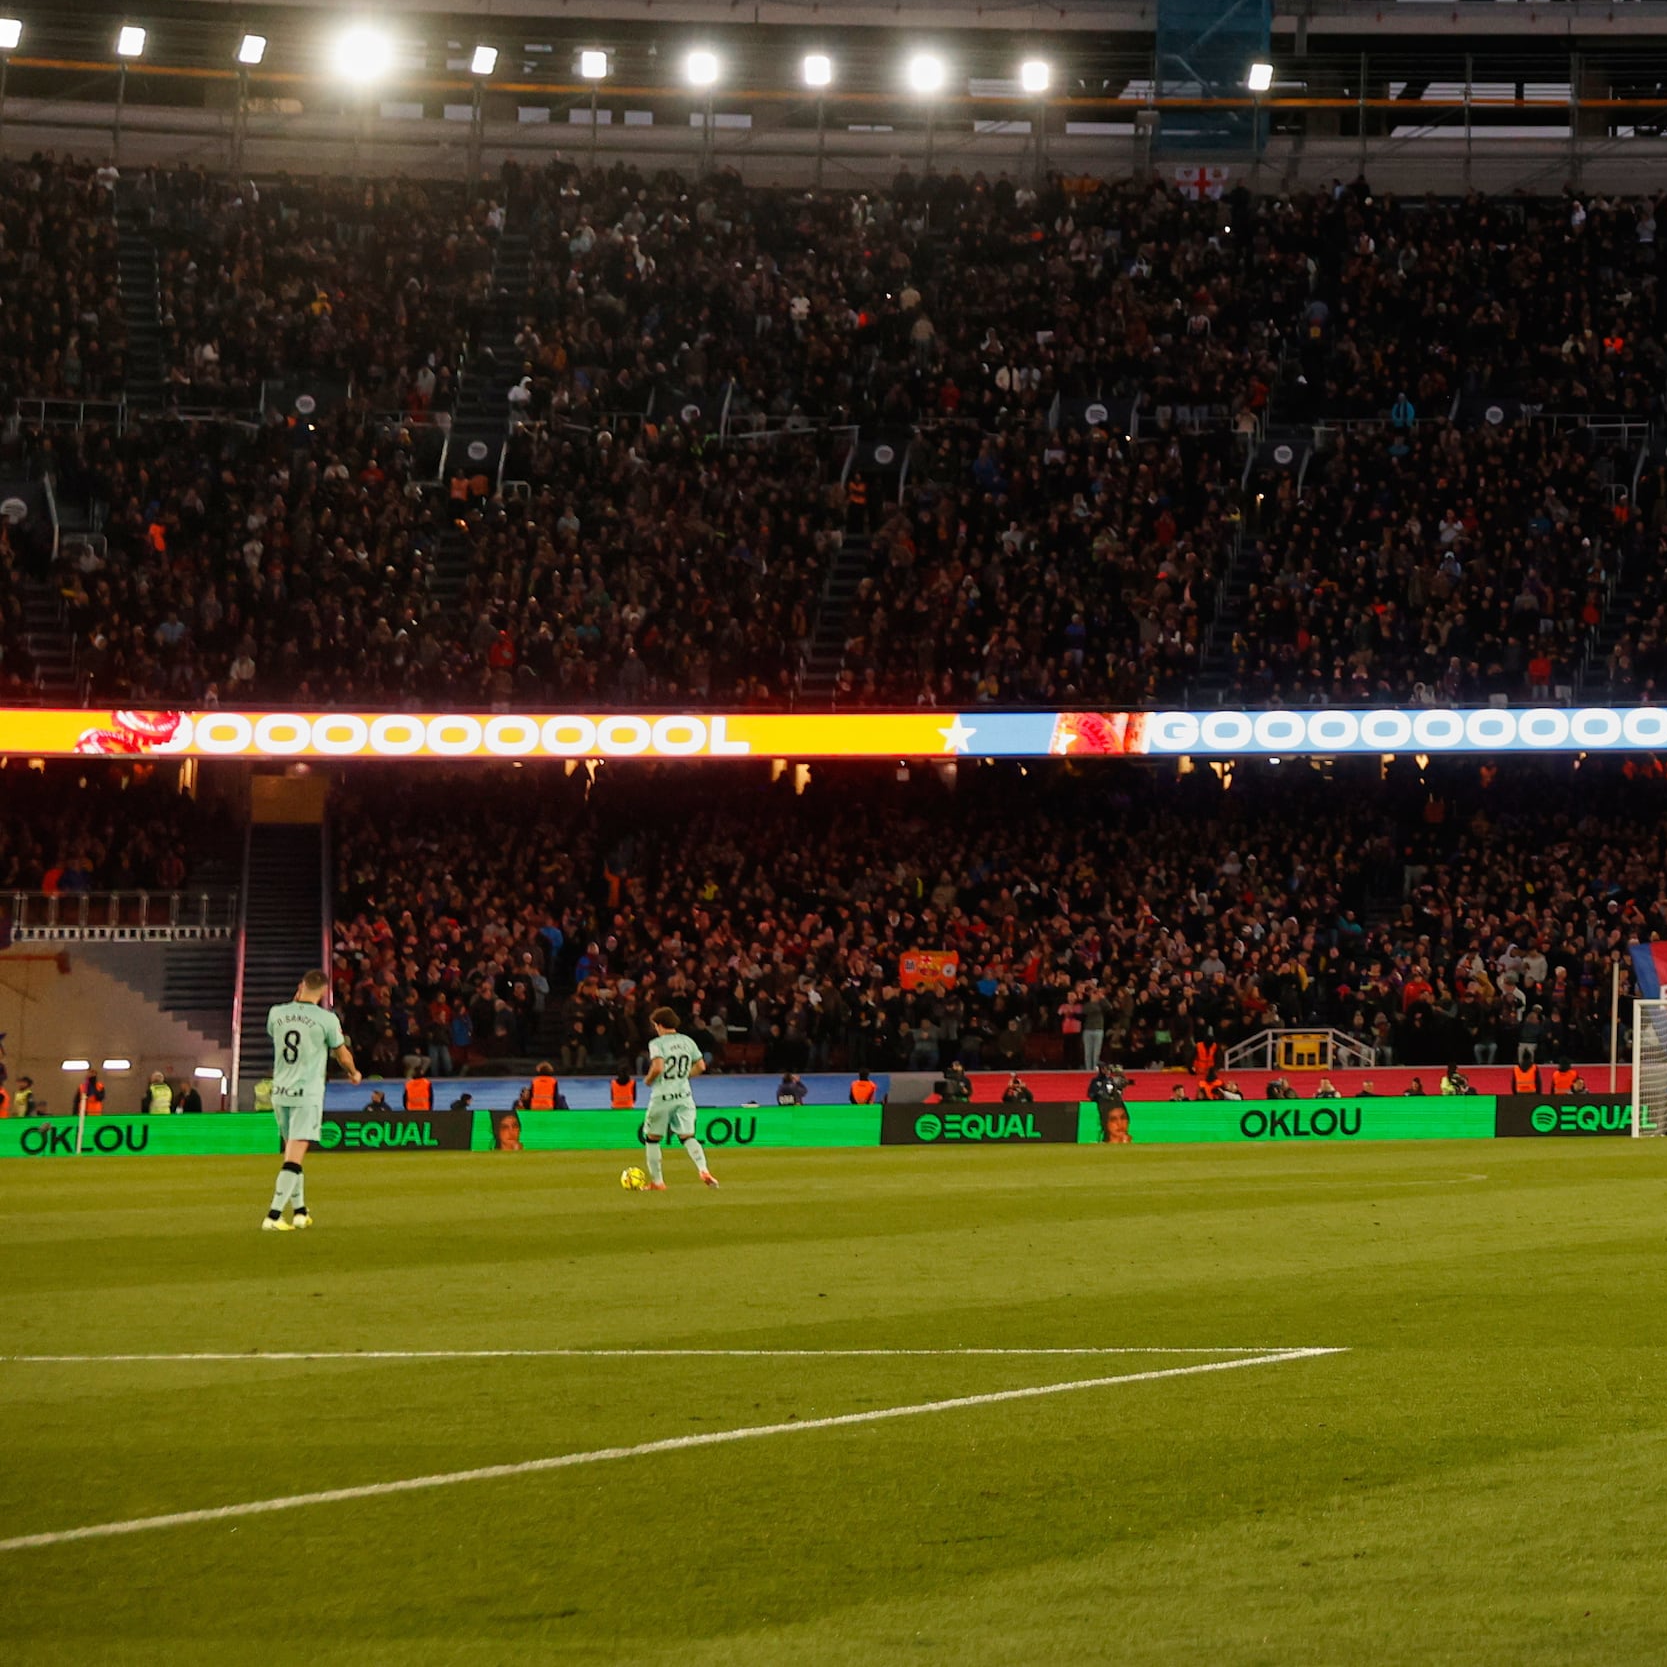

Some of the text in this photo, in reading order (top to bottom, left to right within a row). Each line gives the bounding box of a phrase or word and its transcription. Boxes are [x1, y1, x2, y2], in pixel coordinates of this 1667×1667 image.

[283, 1030, 300, 1064] 8
[664, 1055, 689, 1080] 20
[944, 1113, 1042, 1140] EQUAL
[1240, 1108, 1361, 1138] OKLOU
[1560, 1105, 1657, 1131] EQUAL
[20, 1125, 148, 1154] OKLOU
[344, 1121, 439, 1147] EQUAL
